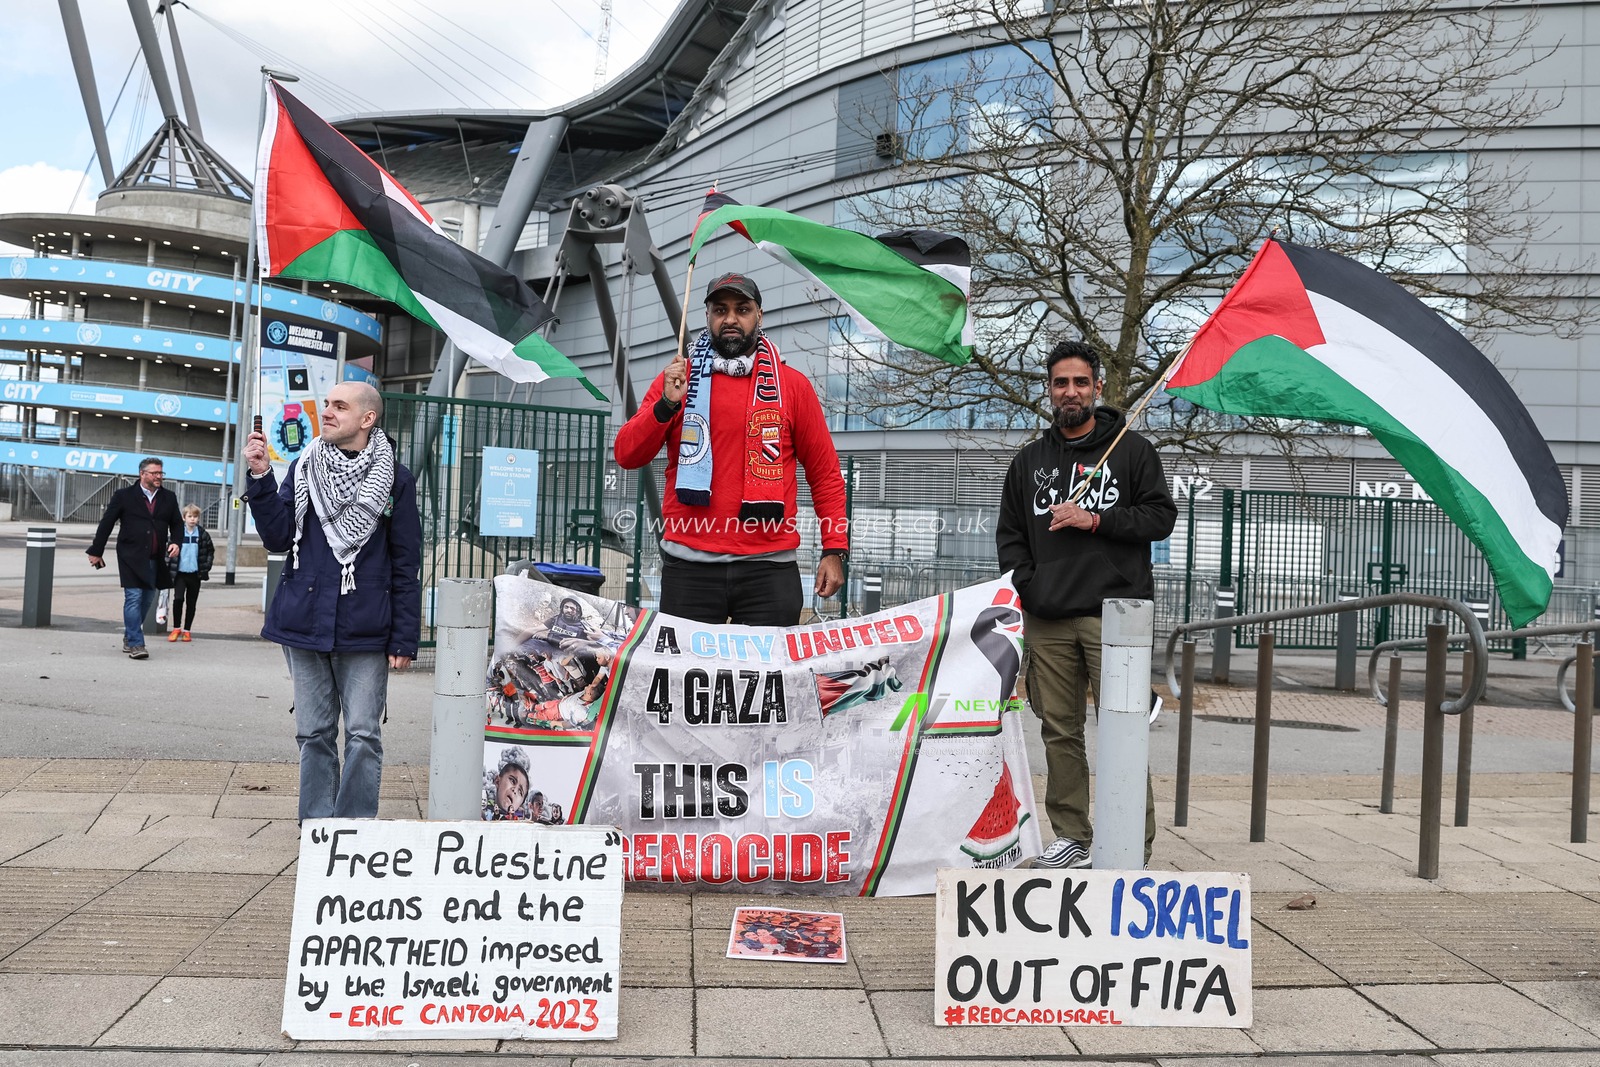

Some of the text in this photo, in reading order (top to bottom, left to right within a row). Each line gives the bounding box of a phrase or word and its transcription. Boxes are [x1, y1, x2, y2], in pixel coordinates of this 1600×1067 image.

[147, 270, 204, 292] CITY
[287, 335, 334, 353] MANCHESTER CITY
[288, 325, 316, 339] WELCOME
[316, 330, 323, 340] TO
[4, 383, 44, 400] CITY
[65, 450, 119, 469] CITY
[756, 467, 783, 476] UNITE
[604, 474, 617, 490] P2
[1173, 475, 1213, 500] N2
[1359, 480, 1401, 507] N2
[653, 615, 925, 663] A CITY UNITED
[646, 667, 788, 727] 4 GAZA
[633, 758, 815, 820] THIS IS
[443, 890, 502, 923] end
[518, 892, 584, 922] the
[956, 876, 1249, 949] KICK ISRAEL
[300, 934, 604, 969] APARTHEID imposed
[298, 970, 613, 1012] by the Israeli government
[946, 954, 1237, 1017] OUT OF FIFA
[943, 1004, 1123, 1026] #REDCARDISRAEL
